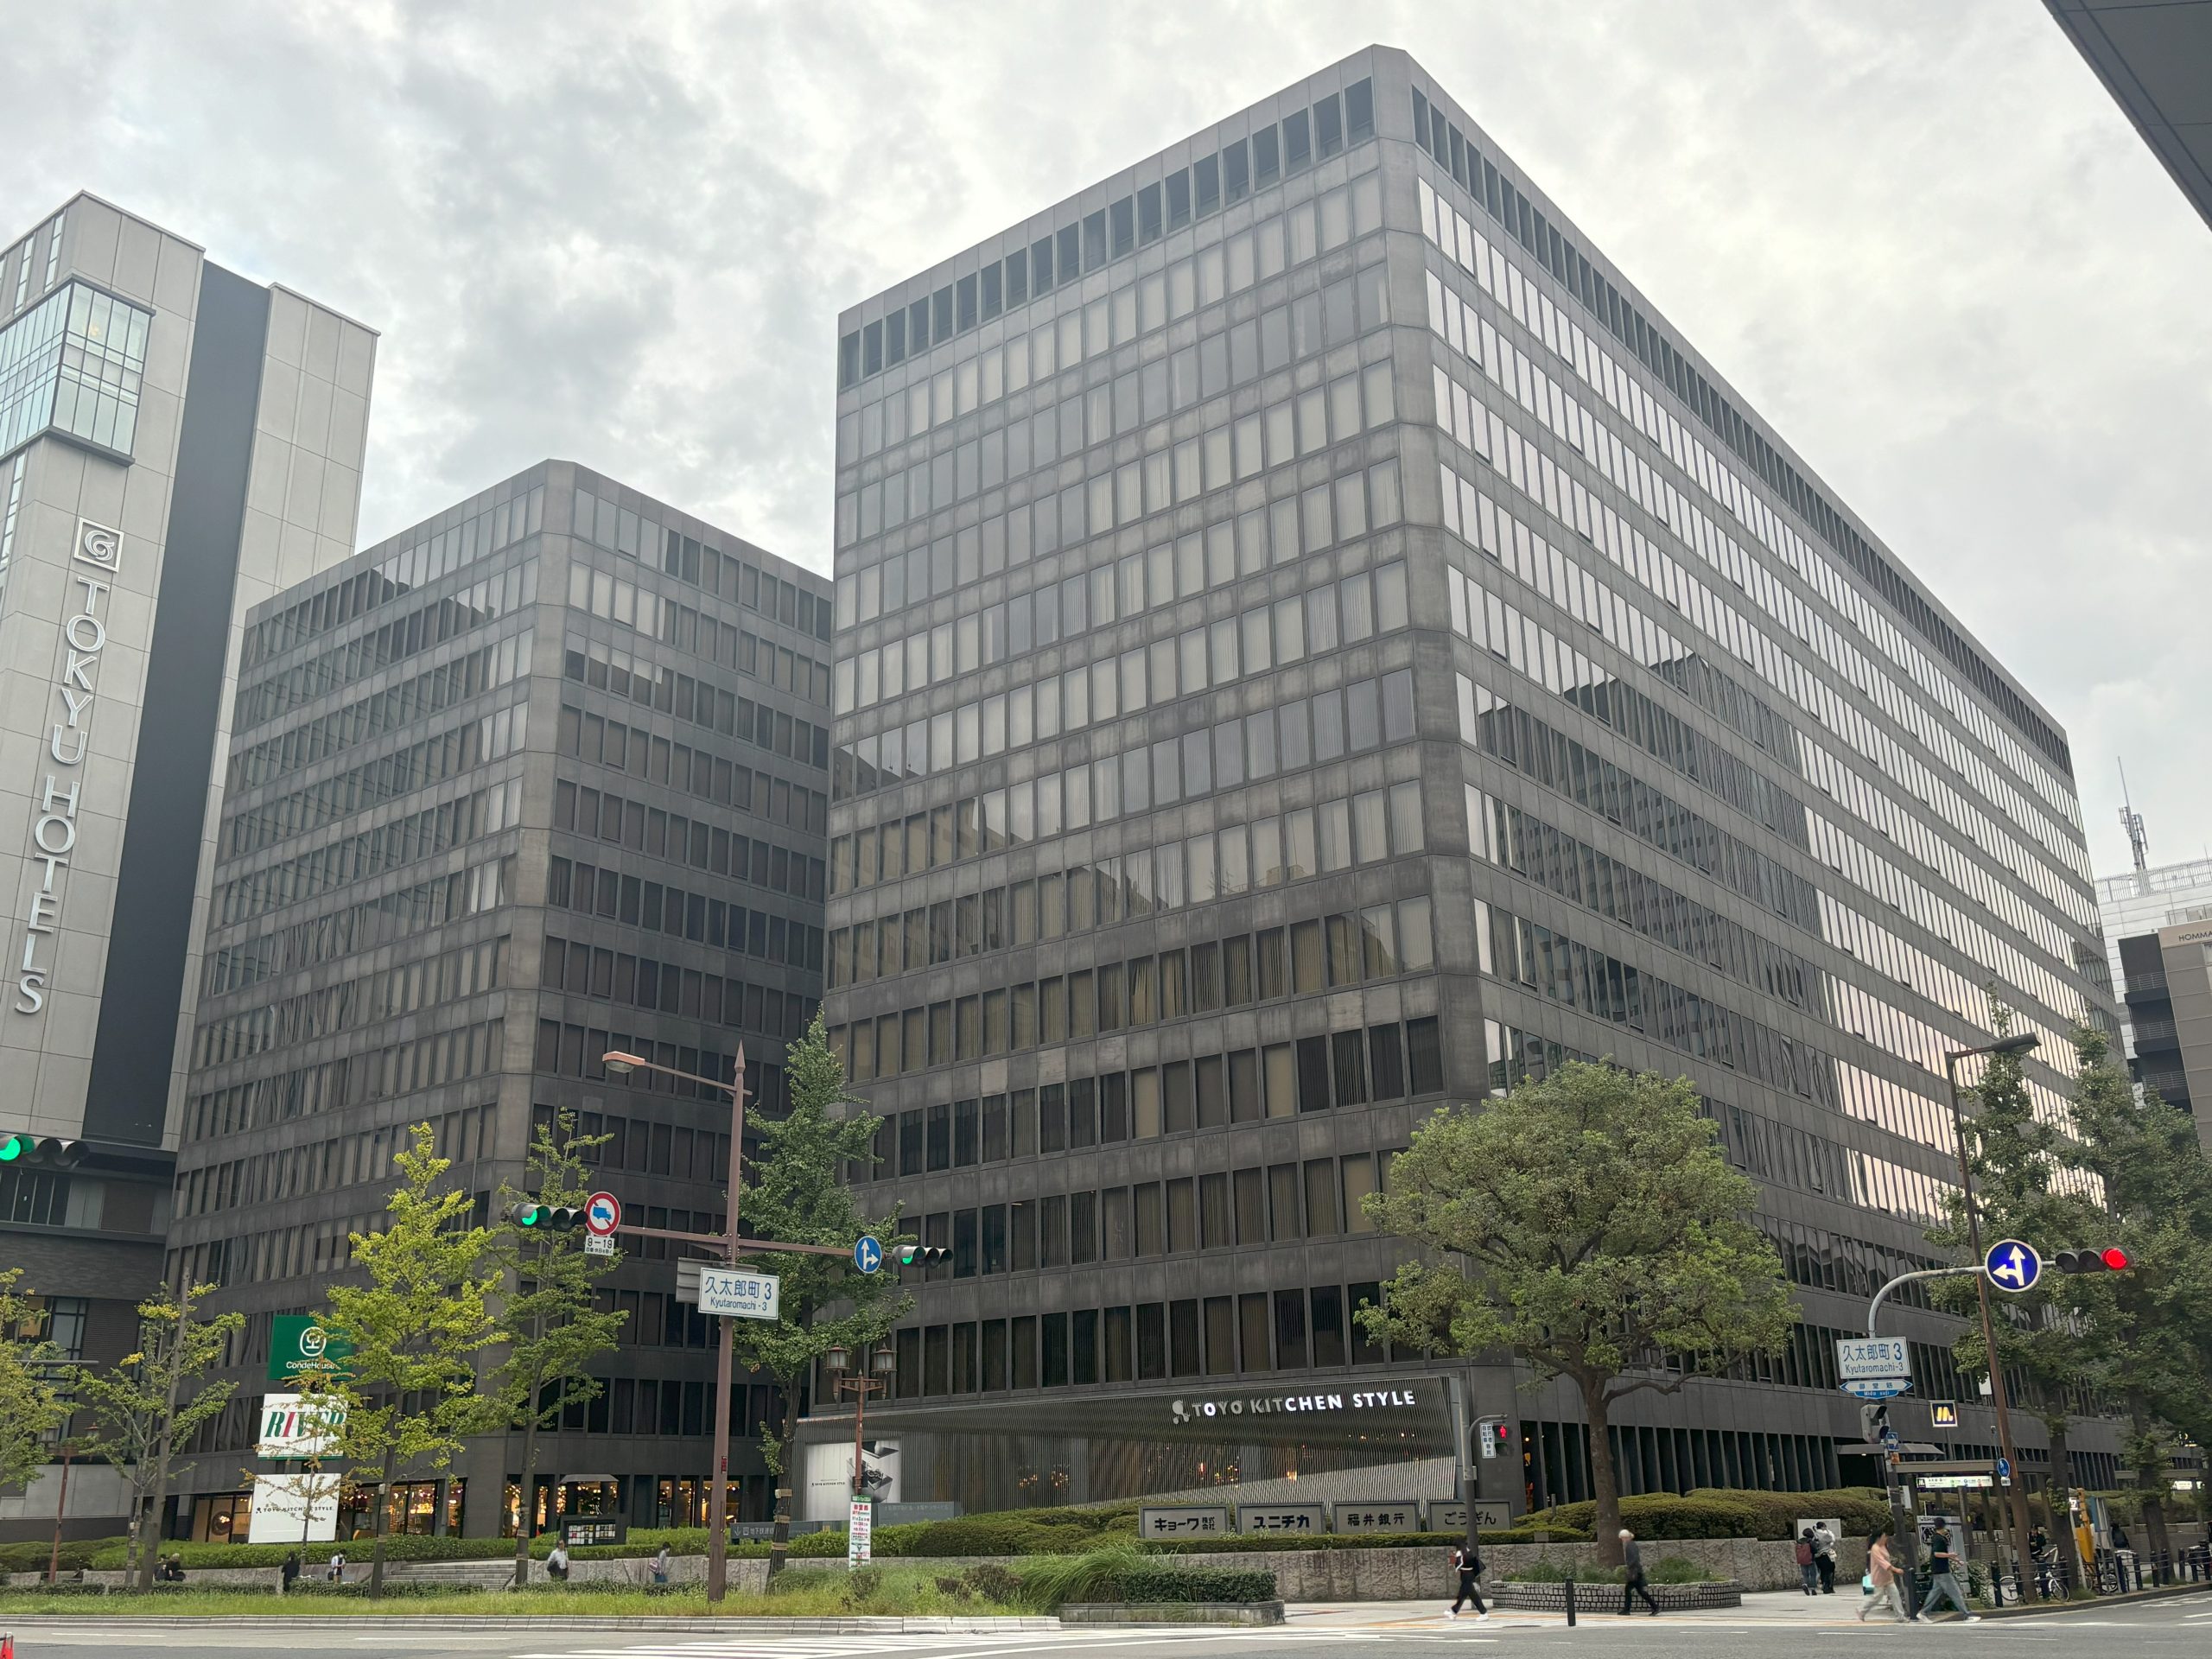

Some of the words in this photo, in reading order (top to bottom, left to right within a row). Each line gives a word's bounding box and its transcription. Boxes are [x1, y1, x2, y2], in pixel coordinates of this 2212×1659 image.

[51, 575, 109, 765] TOKYU
[15, 775, 80, 1015] HOTELS
[1192, 1400, 1243, 1417] TOYO
[1249, 1395, 1343, 1414] KITCHEN
[1352, 1390, 1415, 1408] STYLE
[1154, 1517, 1199, 1531] キョーワ
[1253, 1514, 1310, 1529] ユニチカ
[1347, 1512, 1405, 1527] 福井銀行
